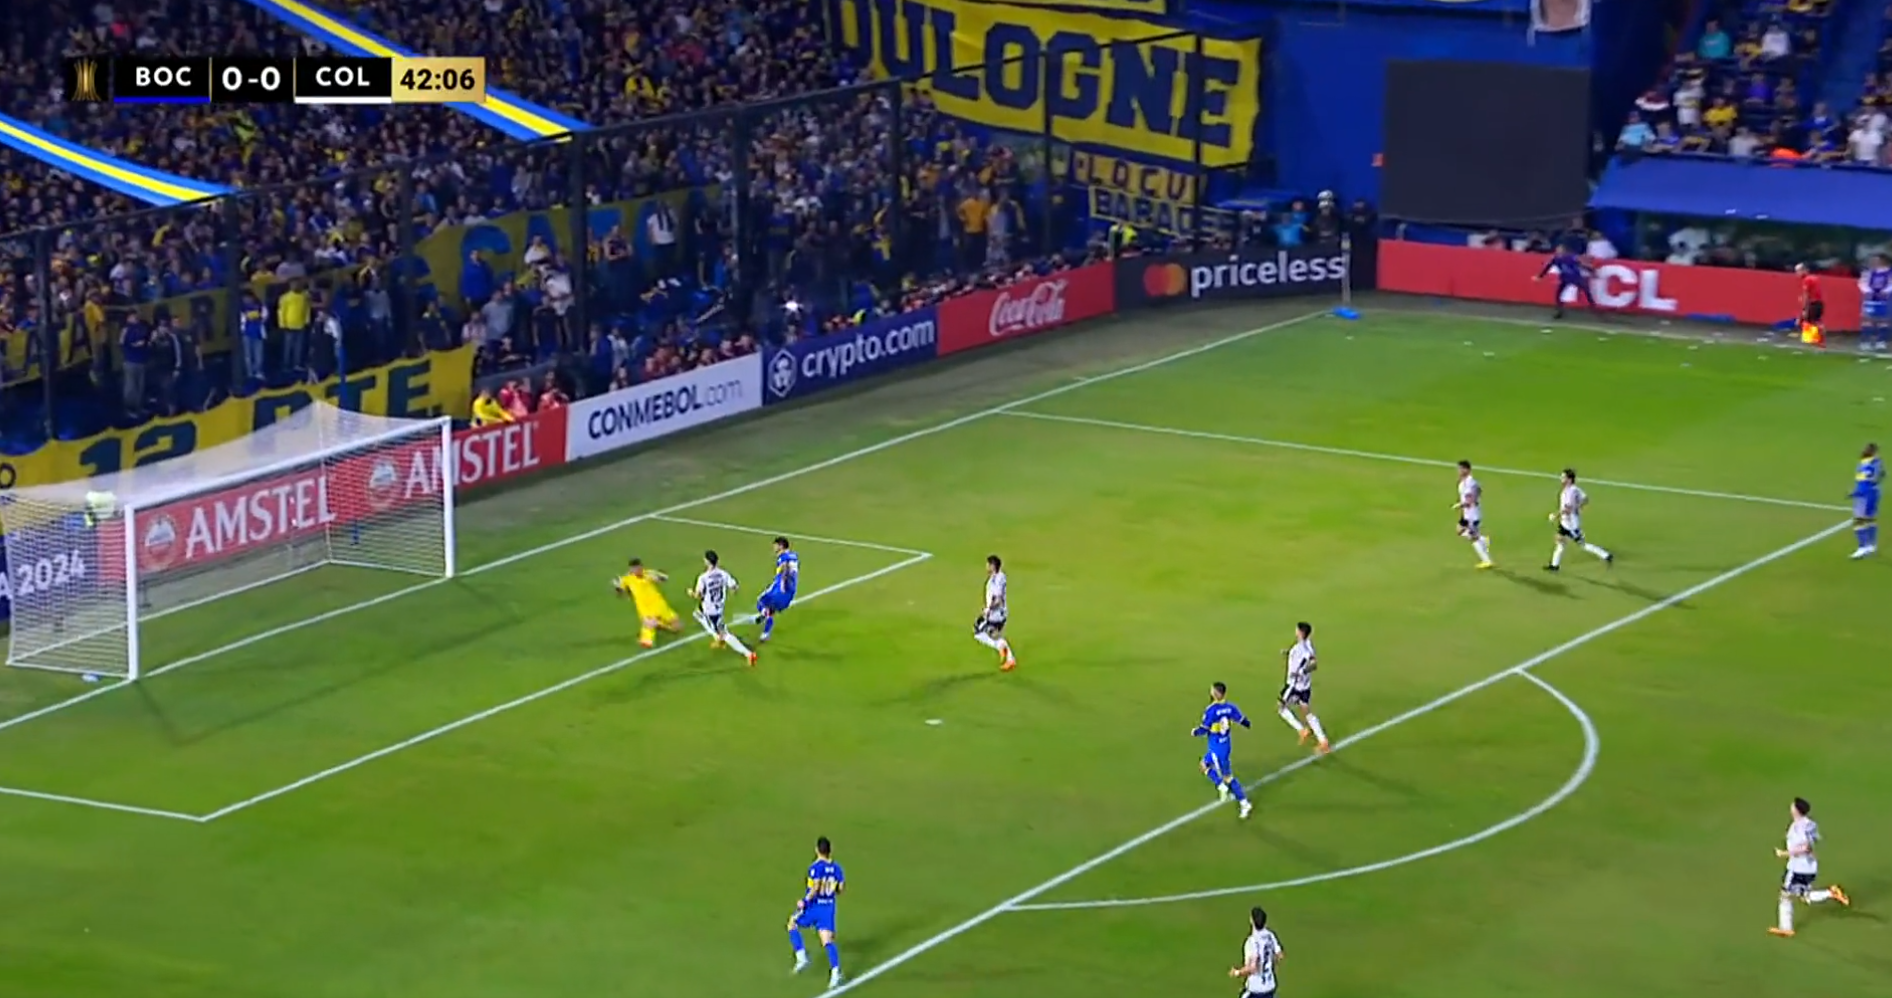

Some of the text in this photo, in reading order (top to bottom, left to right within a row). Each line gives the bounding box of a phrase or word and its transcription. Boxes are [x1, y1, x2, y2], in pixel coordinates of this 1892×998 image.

[1191, 250, 1346, 298] priceless
[1549, 263, 1678, 311] CL
[802, 320, 934, 378] crypto.com
[588, 380, 743, 440] CONMEBOL.com
[404, 422, 539, 500] AMSTEL
[186, 476, 335, 559] AMSTEL
[17, 549, 86, 597] 2024
